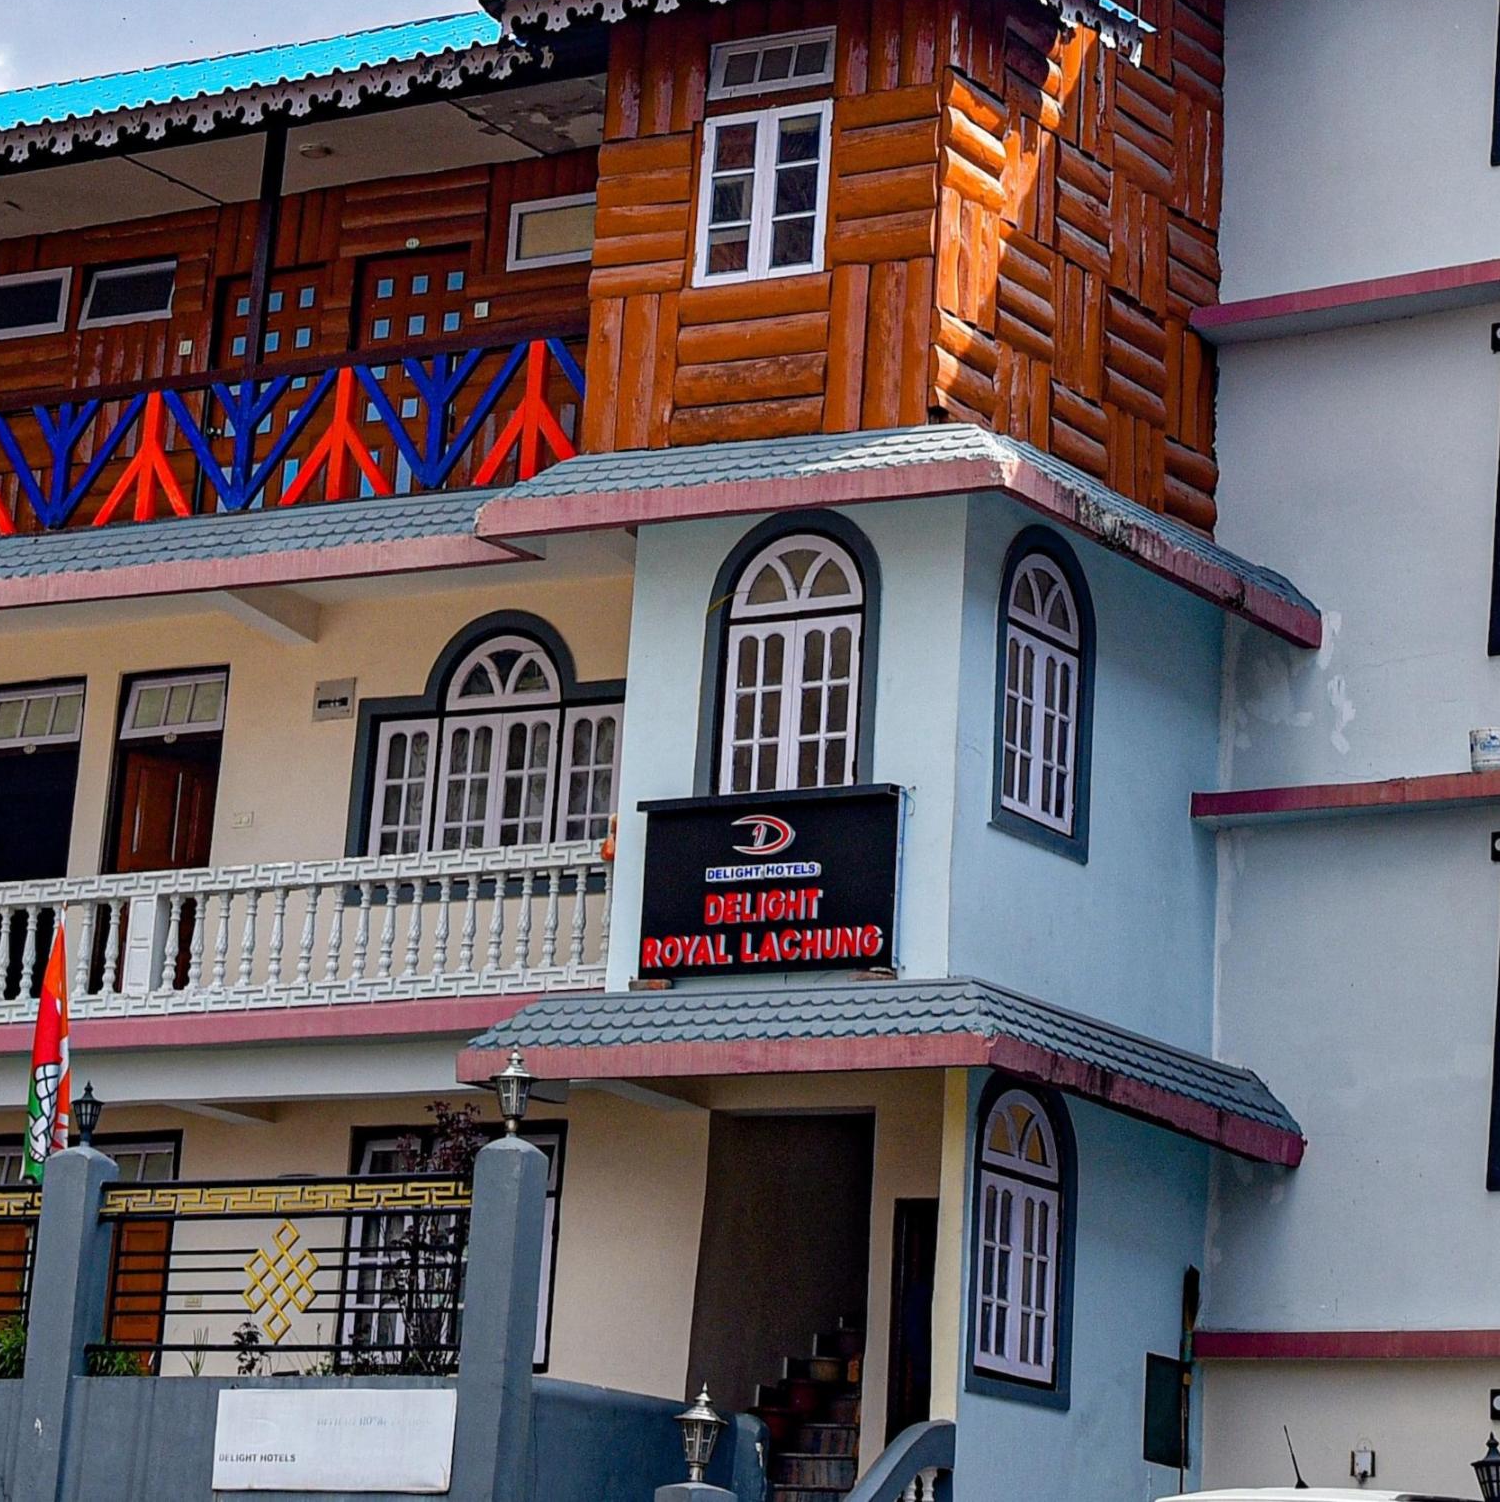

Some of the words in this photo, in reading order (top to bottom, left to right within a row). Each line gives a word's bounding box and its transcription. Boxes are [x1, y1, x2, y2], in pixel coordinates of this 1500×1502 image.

[707, 866, 761, 879] DELIGHT
[766, 864, 817, 876] HOTELS
[704, 888, 824, 925] DELIGHT
[642, 934, 733, 968] ROYAL
[740, 923, 883, 963] LACHUNG
[219, 1454, 257, 1463] DELIGHT
[260, 1453, 296, 1463] HOTELS
